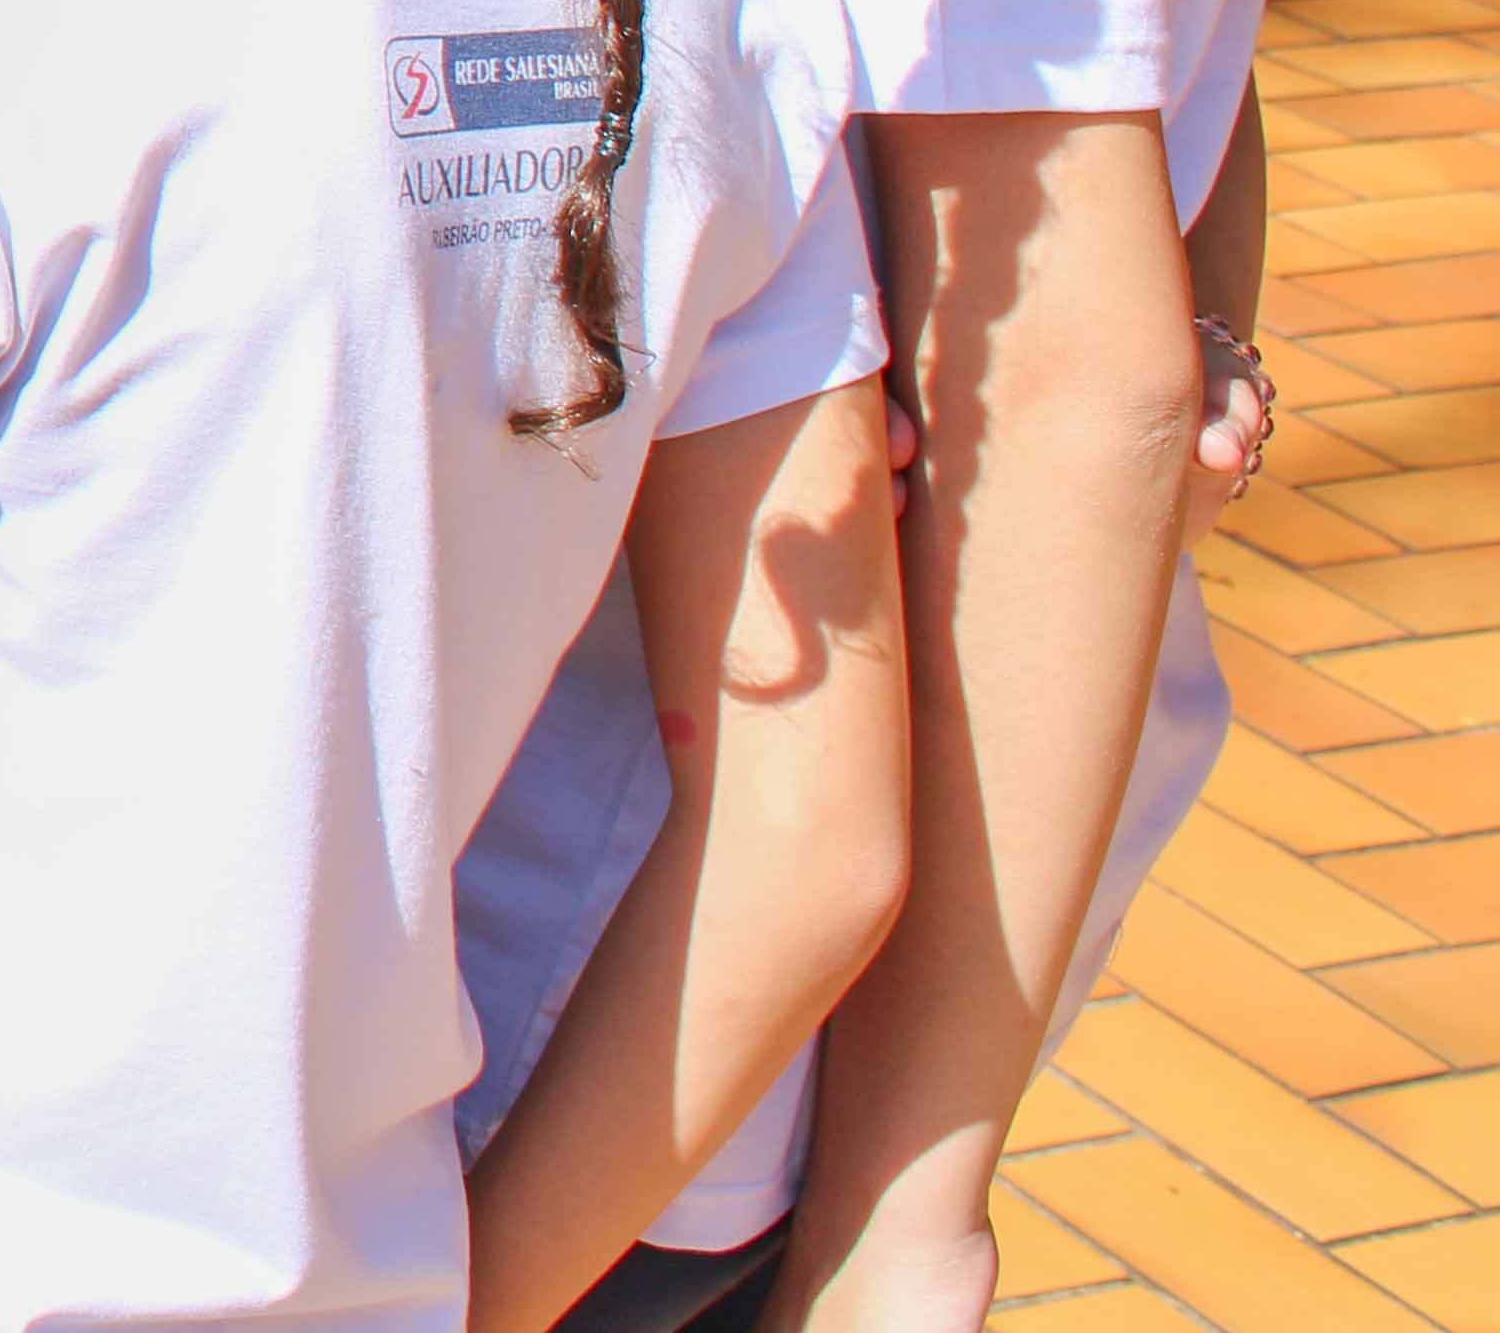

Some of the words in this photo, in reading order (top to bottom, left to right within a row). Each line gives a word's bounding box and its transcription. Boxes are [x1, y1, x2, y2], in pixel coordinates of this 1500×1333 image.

[454, 57, 501, 85] REDE
[553, 79, 602, 101] BRASIL
[399, 145, 584, 206] AUXILIADOR
